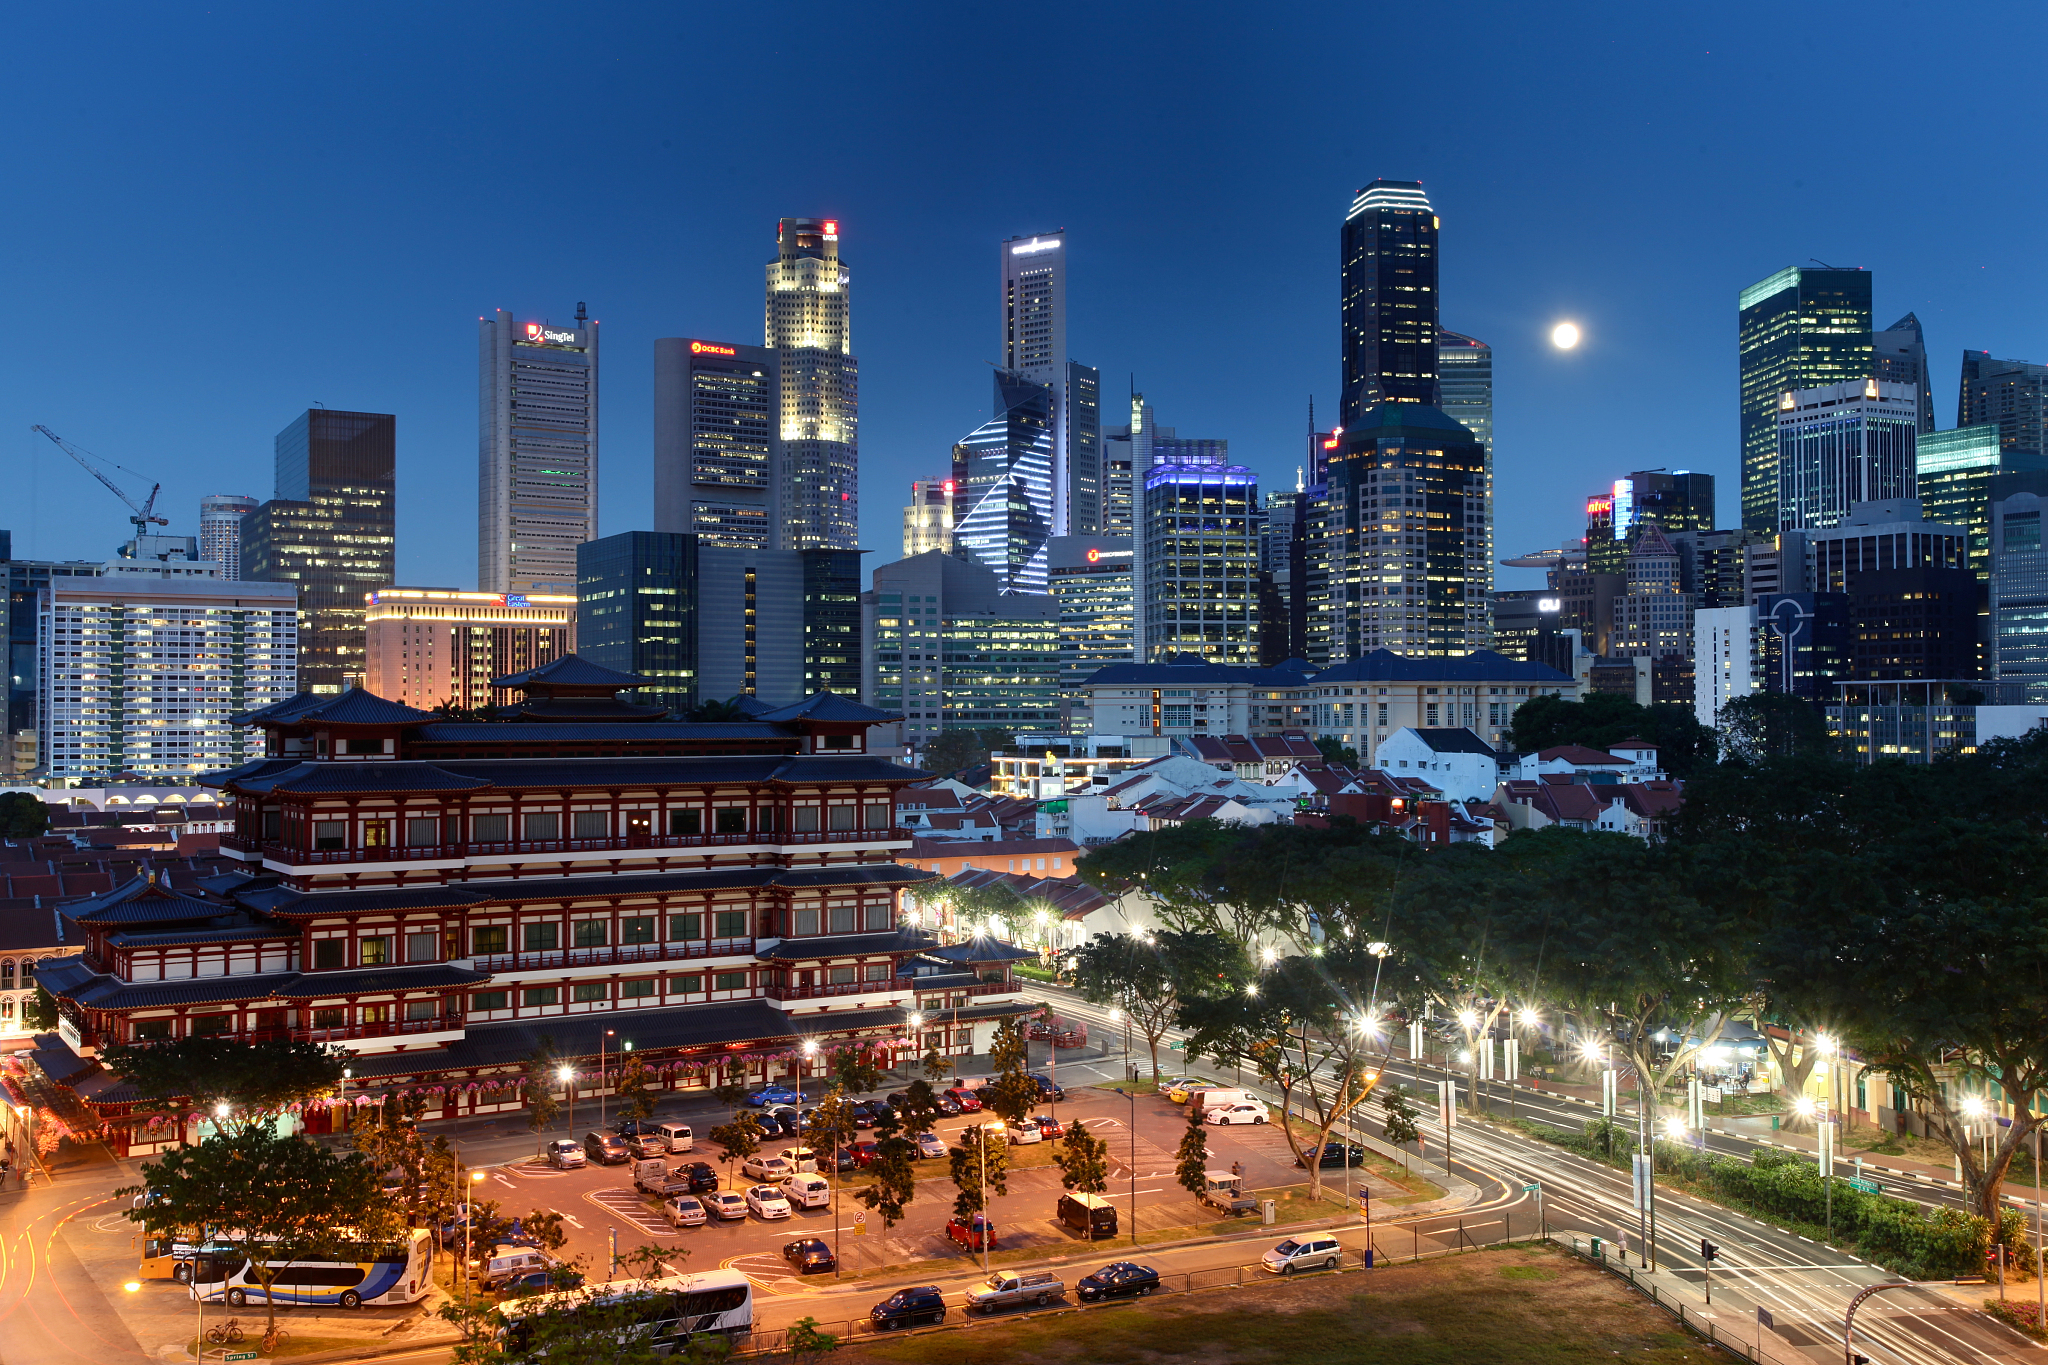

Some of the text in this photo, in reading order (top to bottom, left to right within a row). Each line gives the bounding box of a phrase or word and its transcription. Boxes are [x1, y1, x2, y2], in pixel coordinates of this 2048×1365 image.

[545, 331, 574, 342] SingTel
[701, 345, 735, 356] OCBC Bank
[507, 593, 525, 602] Great
